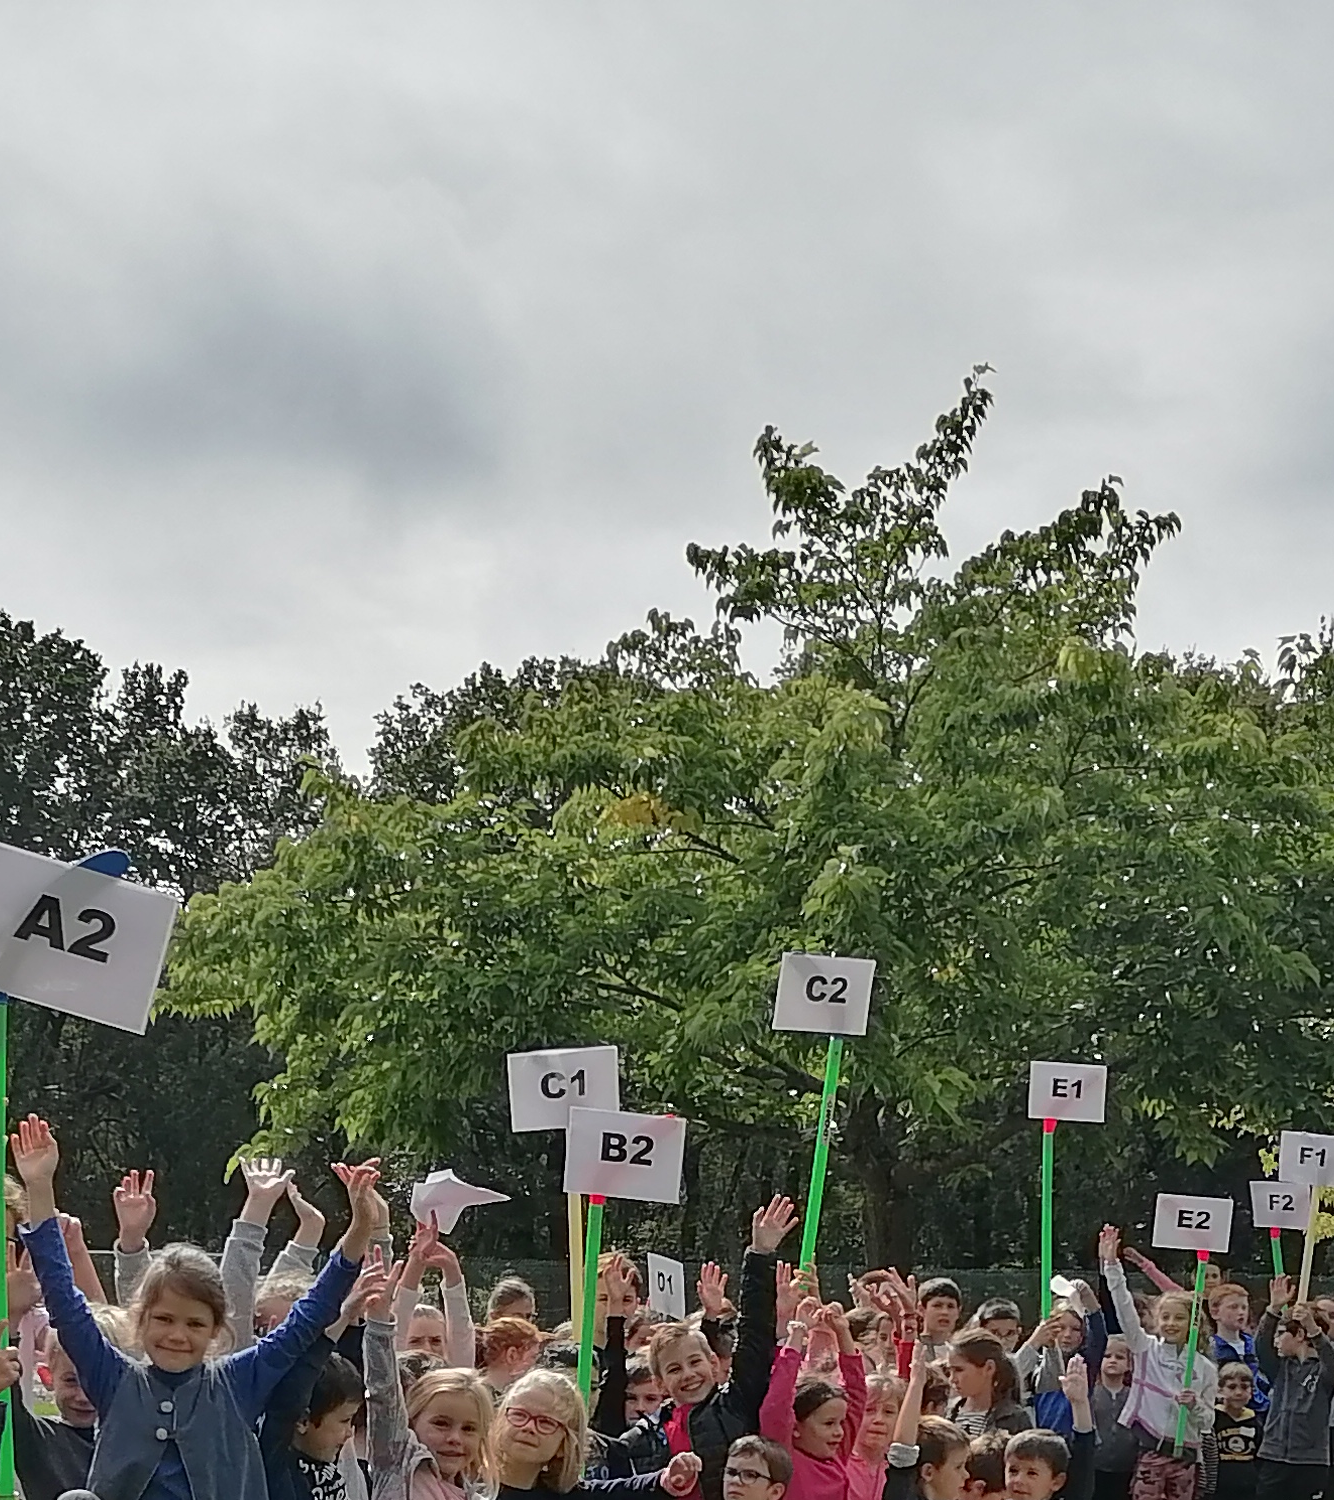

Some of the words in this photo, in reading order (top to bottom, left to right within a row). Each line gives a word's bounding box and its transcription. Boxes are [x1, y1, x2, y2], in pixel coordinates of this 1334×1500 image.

[13, 894, 117, 963] A2
[805, 975, 848, 1004] C2
[540, 1069, 586, 1099] C1
[1051, 1077, 1083, 1099] E1
[600, 1131, 654, 1167] B2
[1299, 1146, 1326, 1168] F1
[1269, 1194, 1295, 1212] F2
[1177, 1209, 1211, 1230] E2
